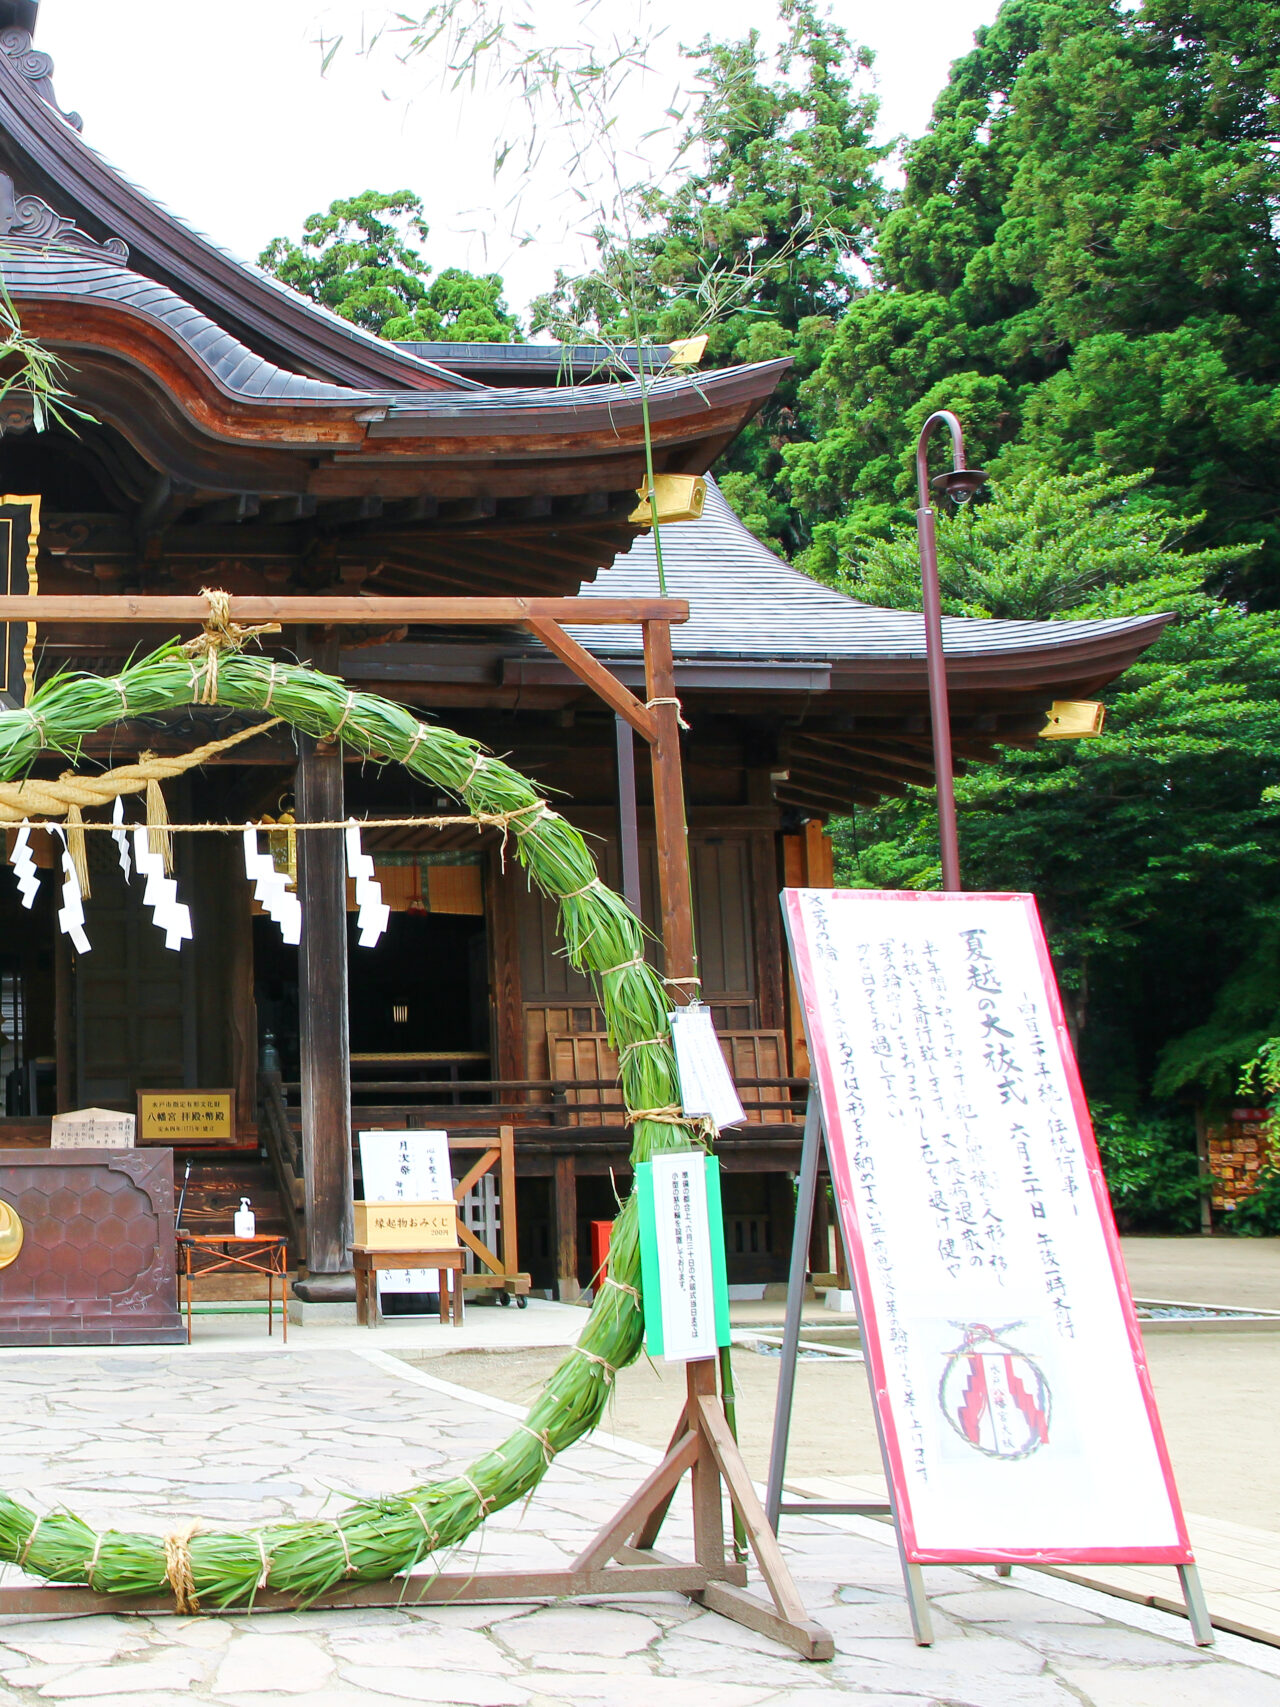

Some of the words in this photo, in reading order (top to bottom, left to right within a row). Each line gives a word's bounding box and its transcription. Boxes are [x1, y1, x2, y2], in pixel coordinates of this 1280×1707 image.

[147, 1111, 177, 1122] 八幡宮
[959, 928, 1029, 1105] 夏越の大祓式
[1009, 1121, 1047, 1220] 六月三十日
